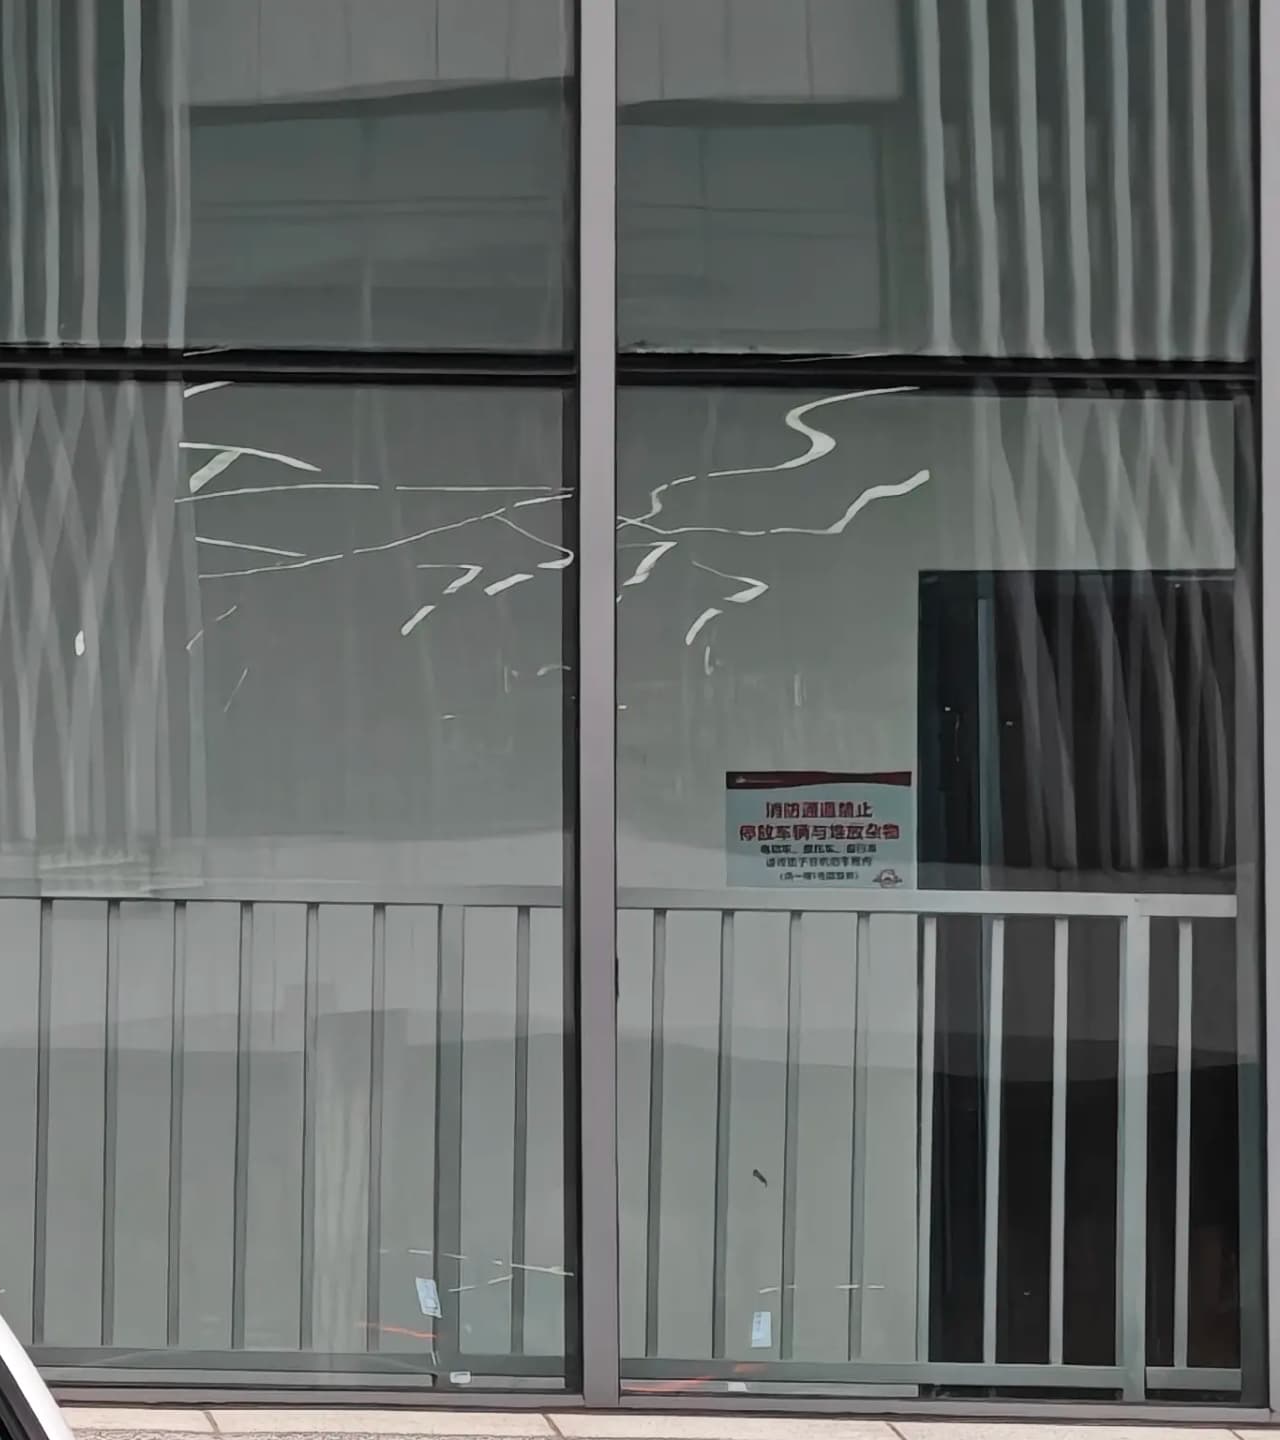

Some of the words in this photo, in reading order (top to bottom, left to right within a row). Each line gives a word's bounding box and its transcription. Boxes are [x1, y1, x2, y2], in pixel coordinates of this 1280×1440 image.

[765, 801, 873, 819] 消防通道禁止
